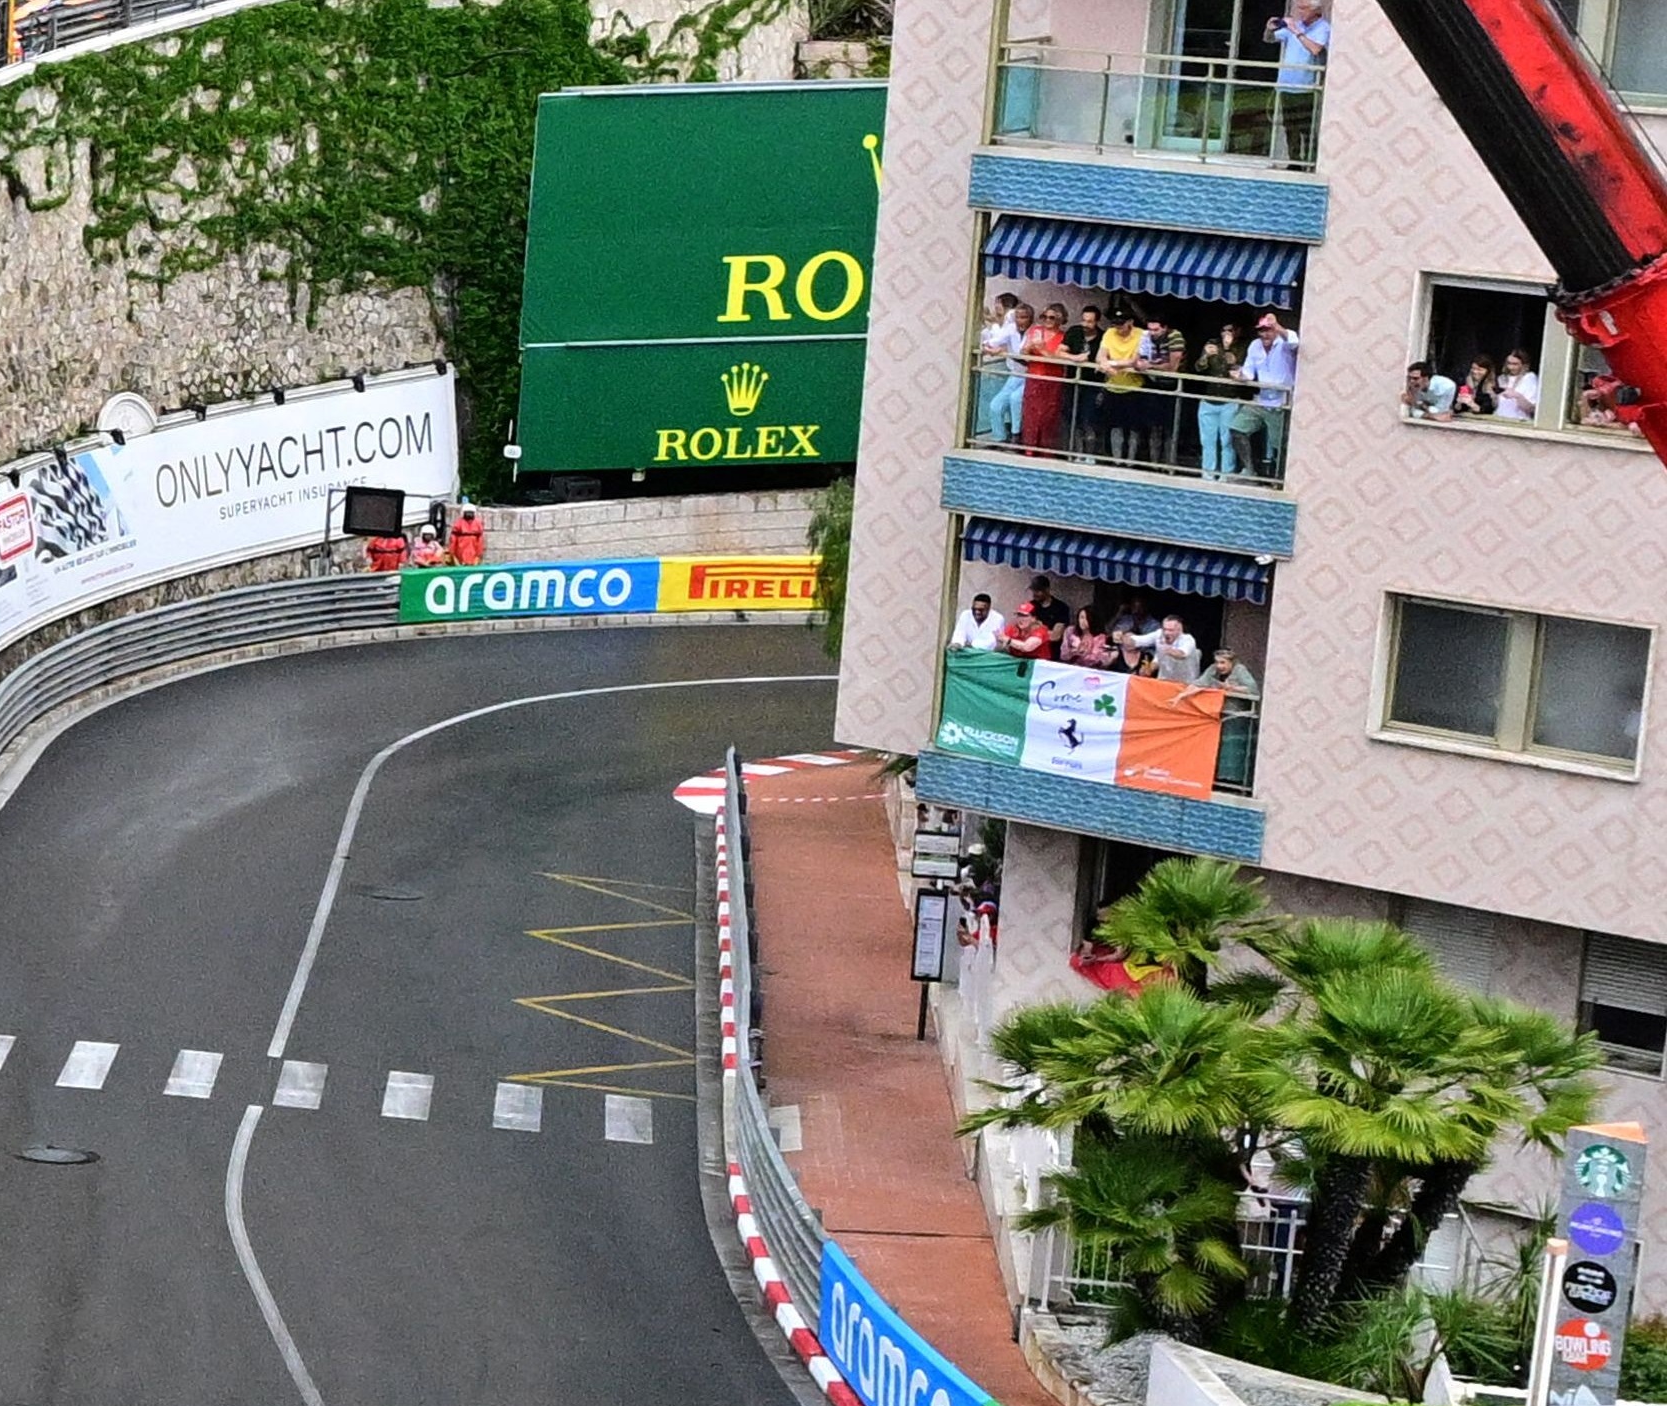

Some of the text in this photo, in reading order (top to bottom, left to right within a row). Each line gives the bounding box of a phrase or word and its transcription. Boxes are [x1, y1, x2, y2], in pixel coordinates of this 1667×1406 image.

[156, 412, 432, 507] ONLYYACHT.COM
[654, 425, 820, 461] ROLEX
[219, 490, 293, 520] SUPERYACHT
[425, 568, 631, 613] aramco
[1555, 1335, 1612, 1356] BOWLING
